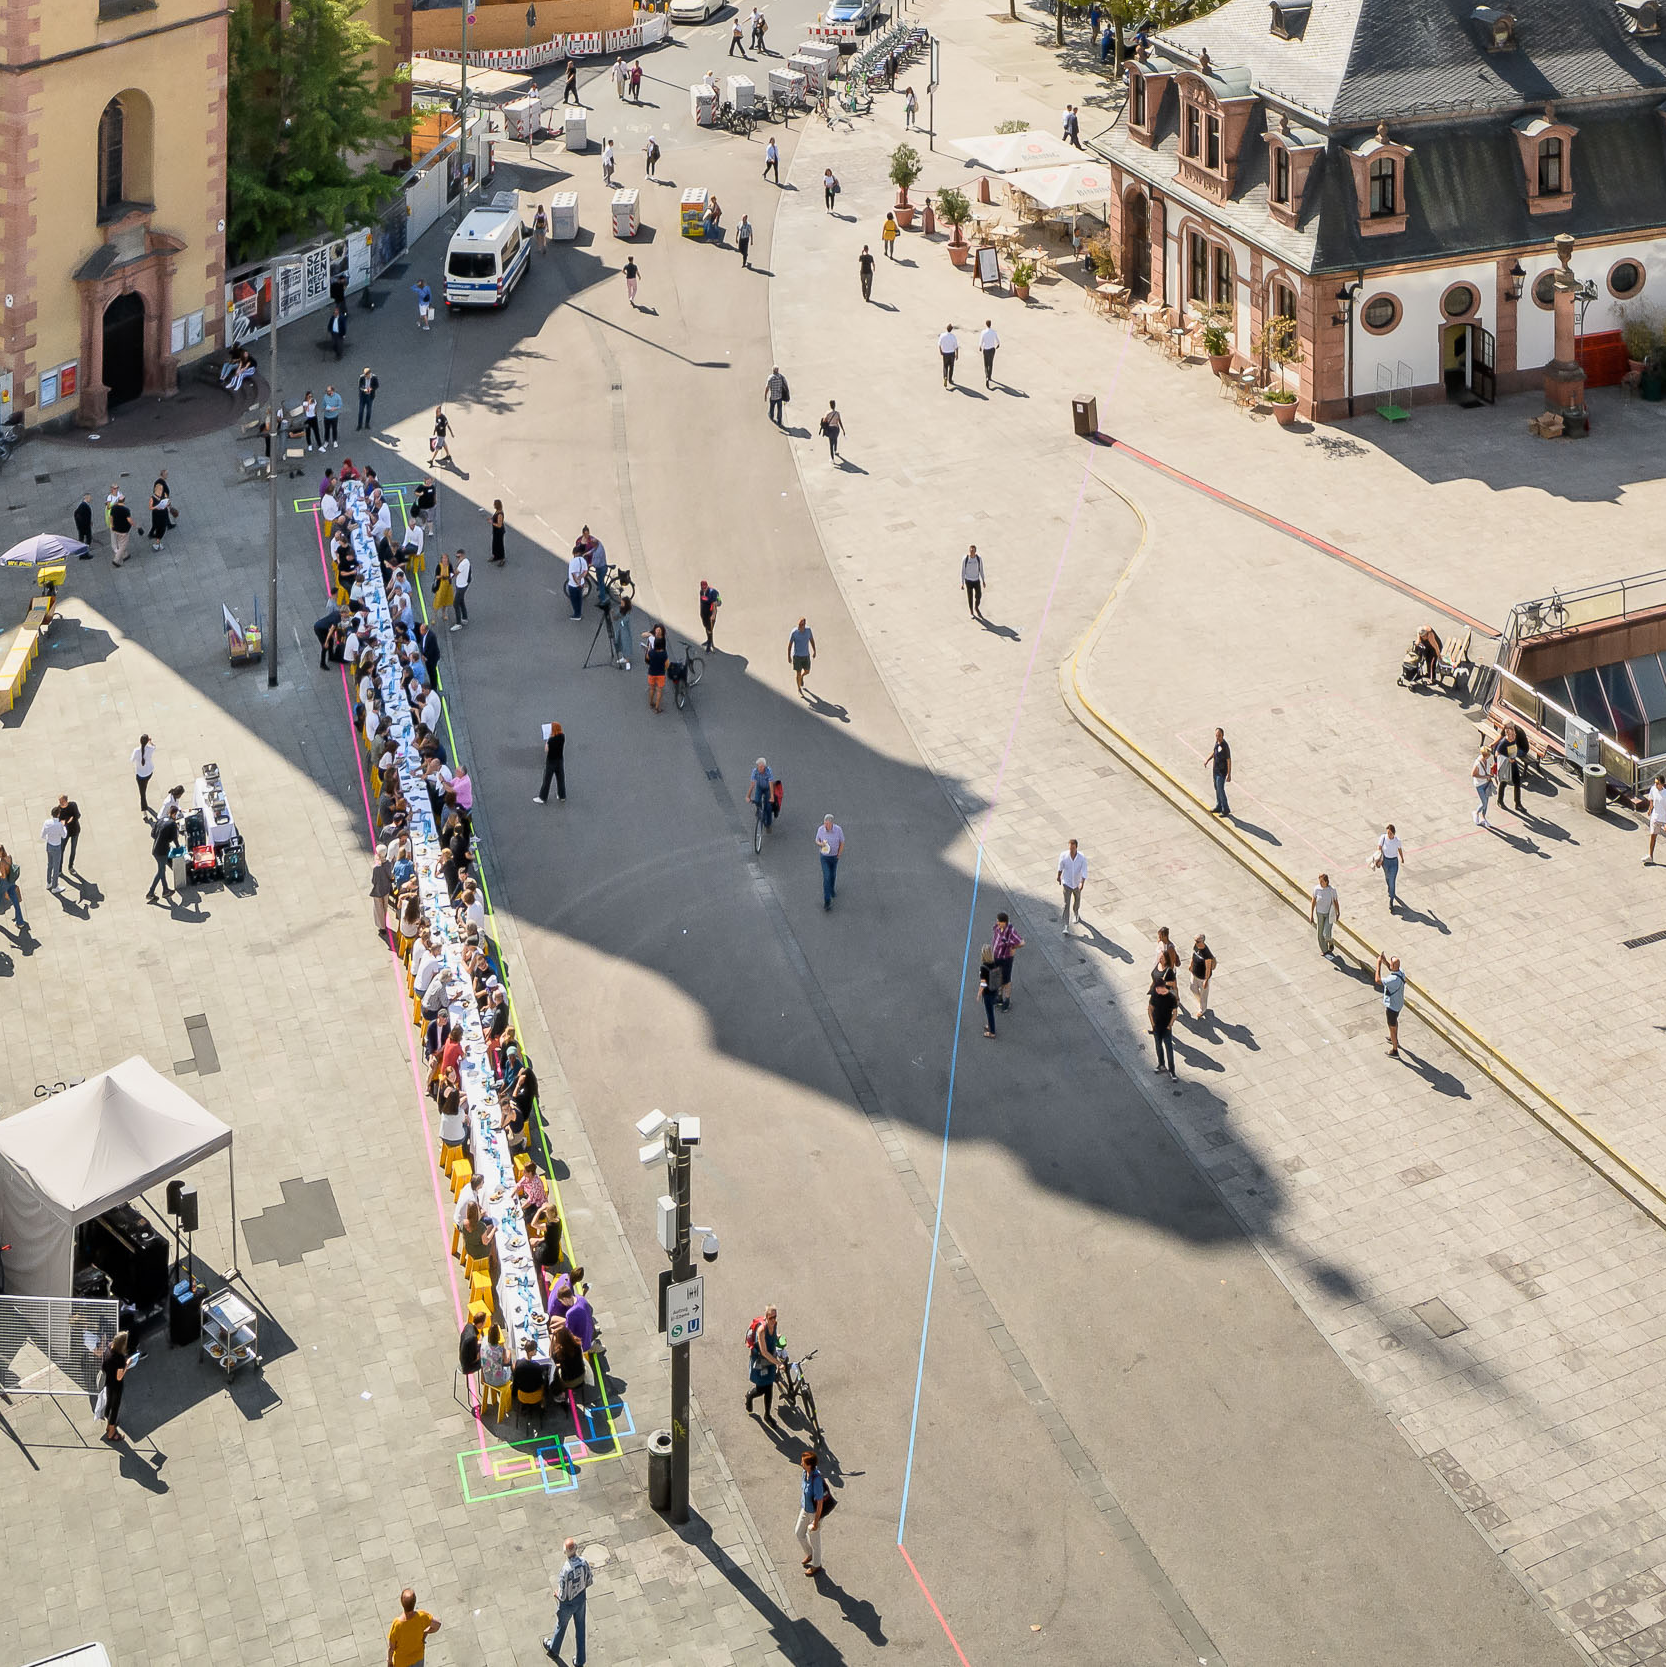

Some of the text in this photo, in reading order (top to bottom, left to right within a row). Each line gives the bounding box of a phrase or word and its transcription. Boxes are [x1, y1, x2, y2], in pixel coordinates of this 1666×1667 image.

[306, 248, 327, 267] SZE
[307, 260, 327, 279] NEN
[307, 272, 328, 287] WECH
[307, 282, 327, 298] SEL
